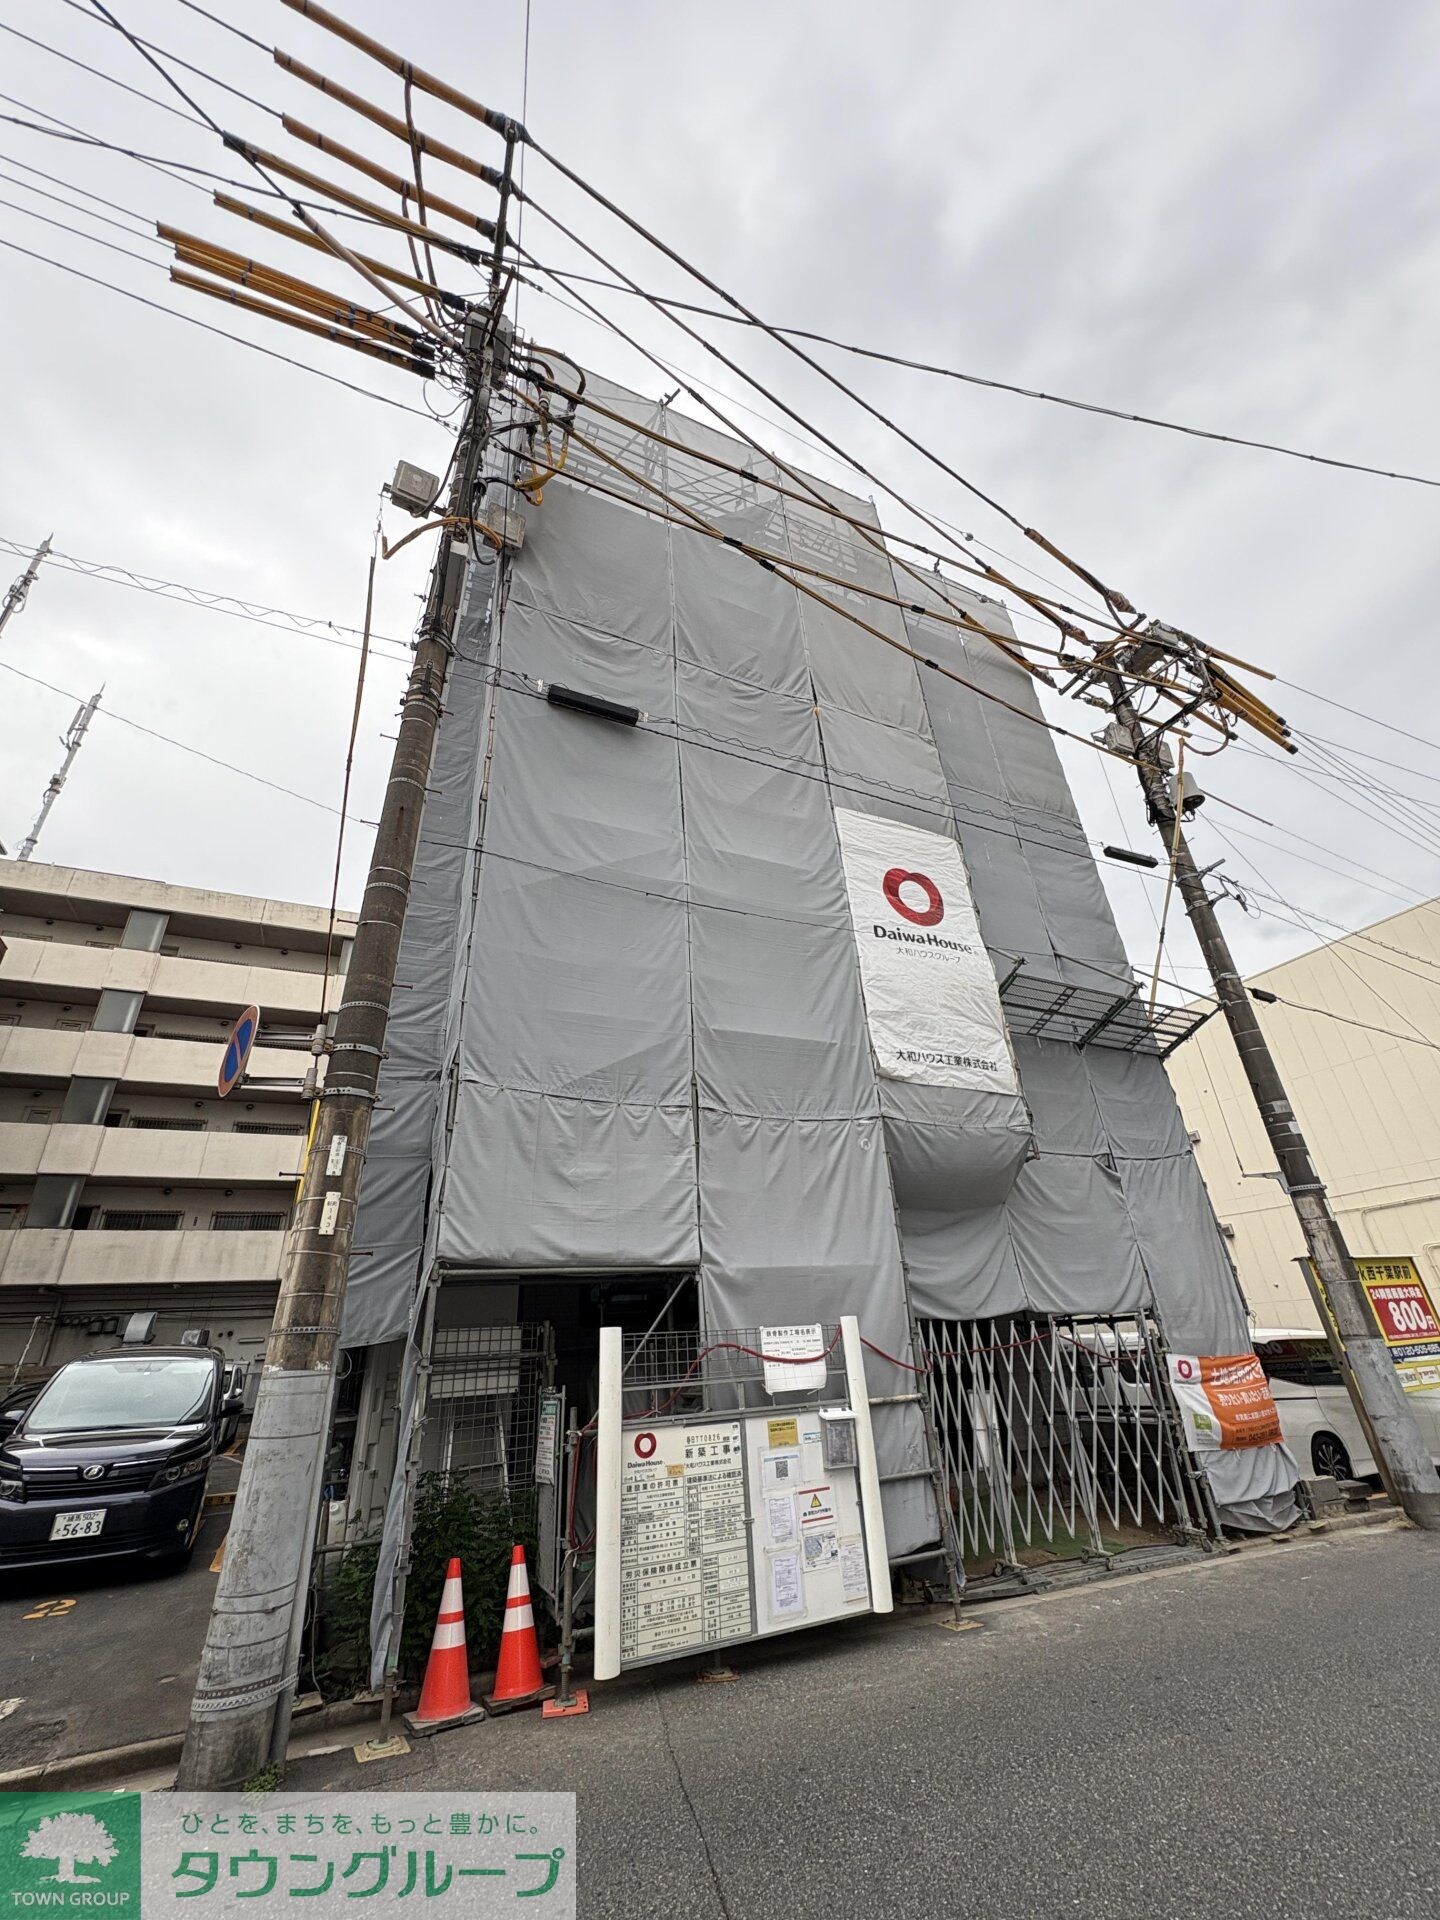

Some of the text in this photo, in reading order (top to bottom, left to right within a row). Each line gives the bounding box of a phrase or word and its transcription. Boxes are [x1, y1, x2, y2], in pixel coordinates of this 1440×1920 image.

[896, 947, 961, 964] 大和ハウスグループ
[896, 1049, 999, 1072] 大和ハウス工業株式会社
[685, 1444, 731, 1459] 新築工事
[685, 1458, 732, 1469] 大和ハウス工業株式会社
[687, 1470, 742, 1484] 建築基準法による確認済
[626, 1479, 679, 1492] 建設業の許可票
[62, 1521, 101, 1537] 56-83
[625, 1560, 697, 1579] 労災保険関係成立票
